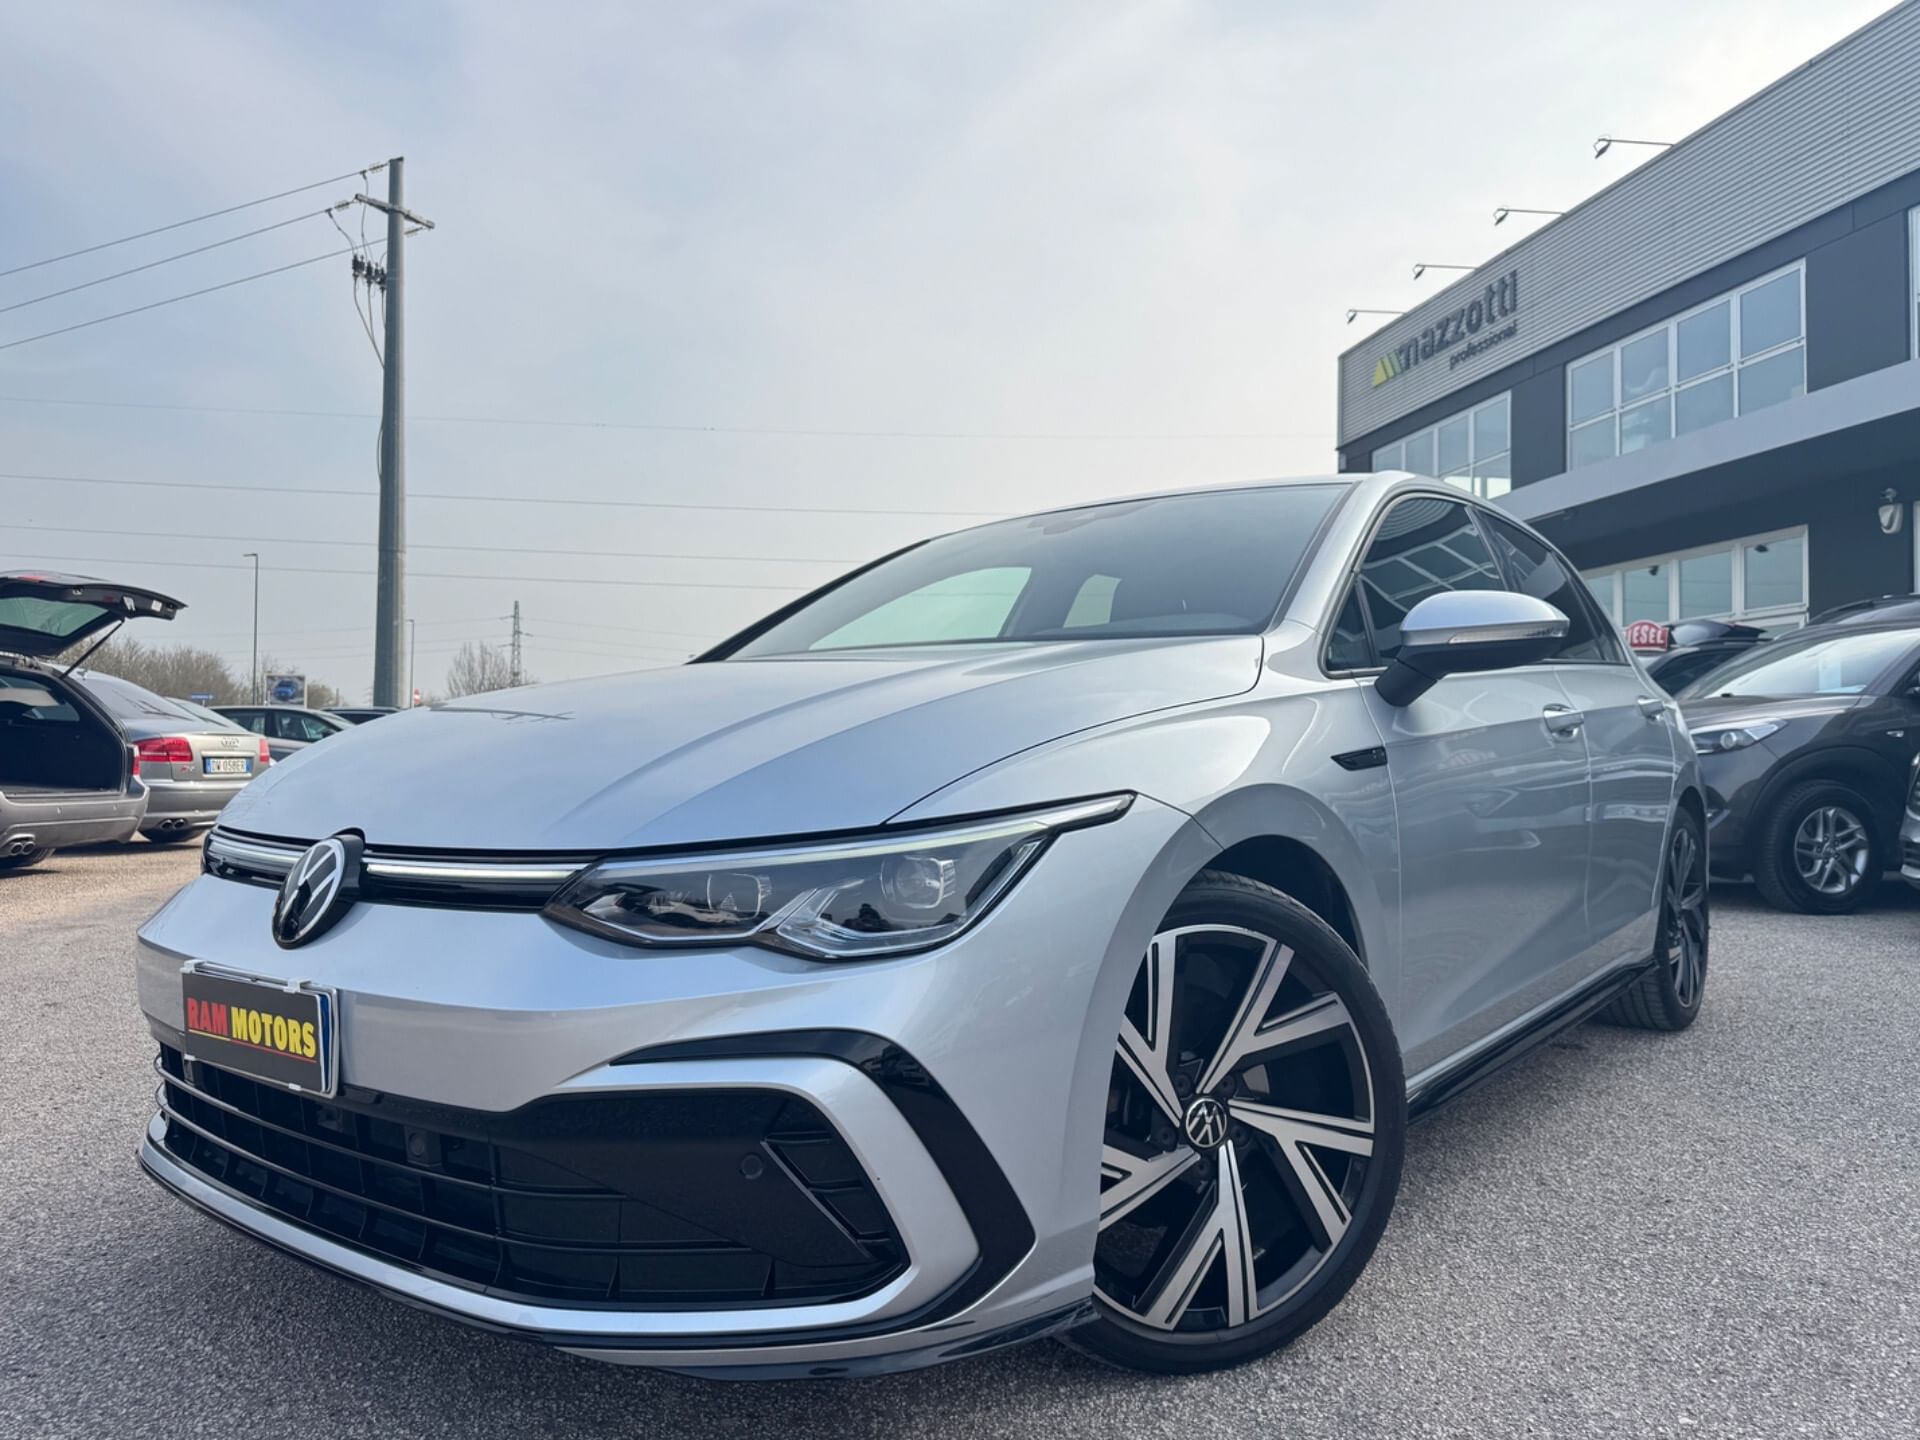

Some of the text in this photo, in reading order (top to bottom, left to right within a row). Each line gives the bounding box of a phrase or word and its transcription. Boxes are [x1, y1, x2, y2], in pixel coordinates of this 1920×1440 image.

[1394, 268, 1518, 373] mazzotti
[1449, 319, 1518, 370] professional
[1623, 624, 1665, 645] IESEL
[187, 997, 317, 1058] RAM MOTORS
